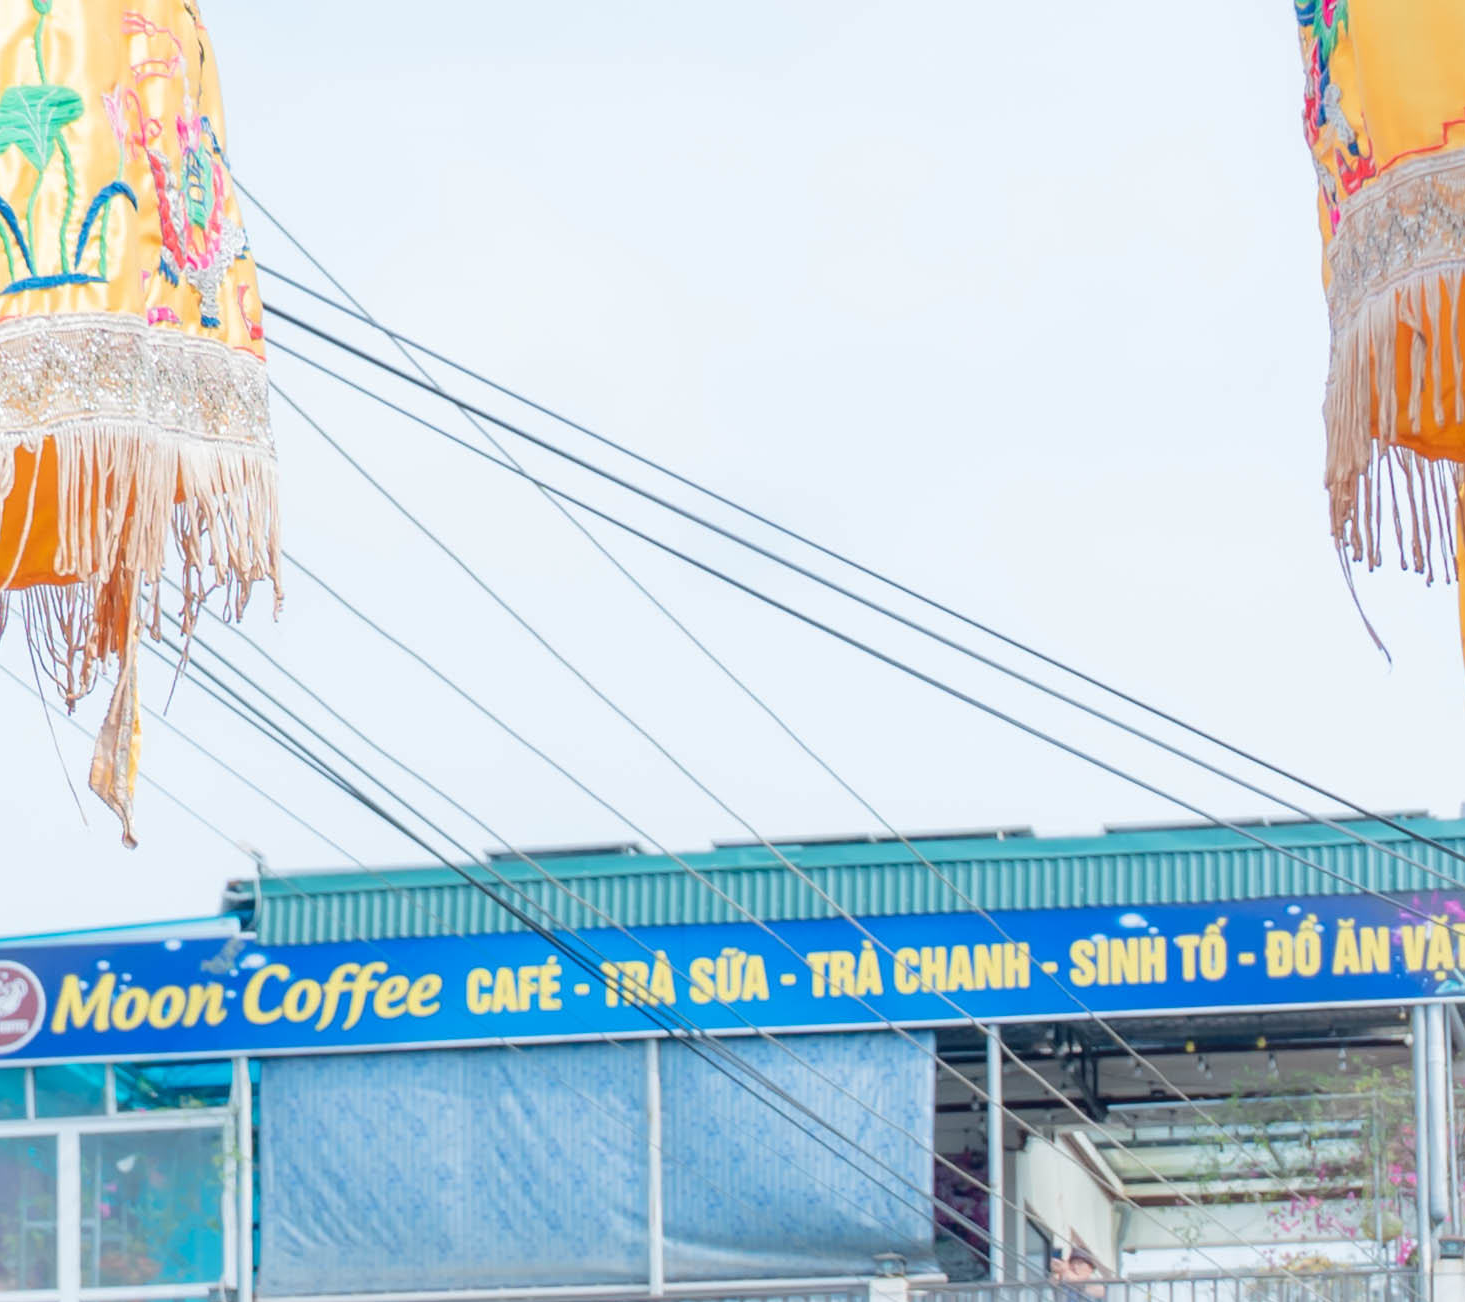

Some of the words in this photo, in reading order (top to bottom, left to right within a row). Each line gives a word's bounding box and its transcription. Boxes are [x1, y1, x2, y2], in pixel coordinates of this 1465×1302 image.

[51, 972, 227, 1034] Moon
[242, 961, 443, 1032] Coffee
[466, 955, 563, 1015] CAFÉ
[600, 949, 676, 1008] TRÀ
[689, 947, 770, 1004] SỮA
[806, 940, 883, 998] TRÀ
[893, 942, 1031, 995] CHANH
[1069, 936, 1167, 988] SINH
[1177, 917, 1228, 982] TỐ
[1332, 917, 1390, 975] ĂN
